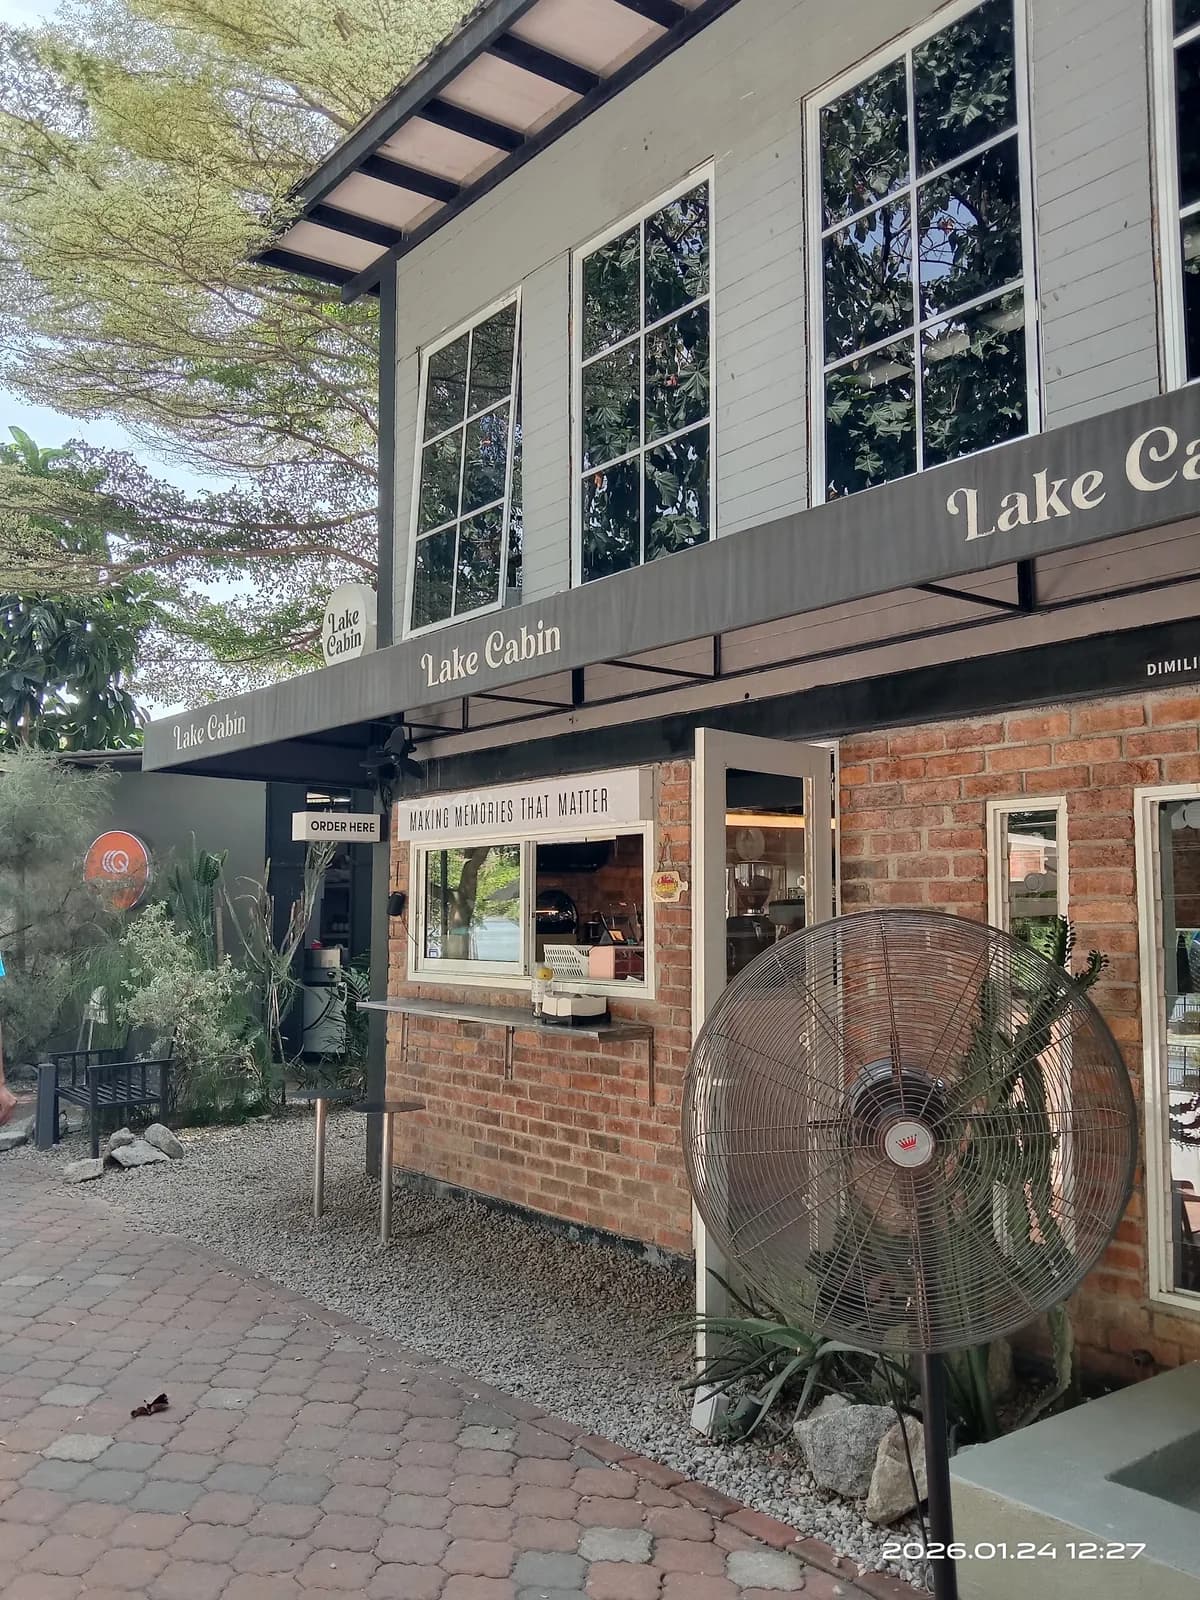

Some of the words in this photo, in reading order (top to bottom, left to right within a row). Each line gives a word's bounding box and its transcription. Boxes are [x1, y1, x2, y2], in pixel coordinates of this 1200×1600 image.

[946, 467, 1106, 542] Lake
[328, 609, 360, 634] Lake
[326, 629, 362, 657] Cabin
[420, 648, 479, 687] Lake
[485, 619, 561, 669] Cabin
[173, 723, 205, 751] Lake
[207, 711, 246, 741] Cabin
[310, 821, 347, 832] ORDER
[349, 822, 376, 833] HERE
[409, 808, 449, 832] MAKING
[455, 800, 513, 827] MEMORIES
[520, 794, 549, 820] THAT
[558, 787, 609, 817] MATTER
